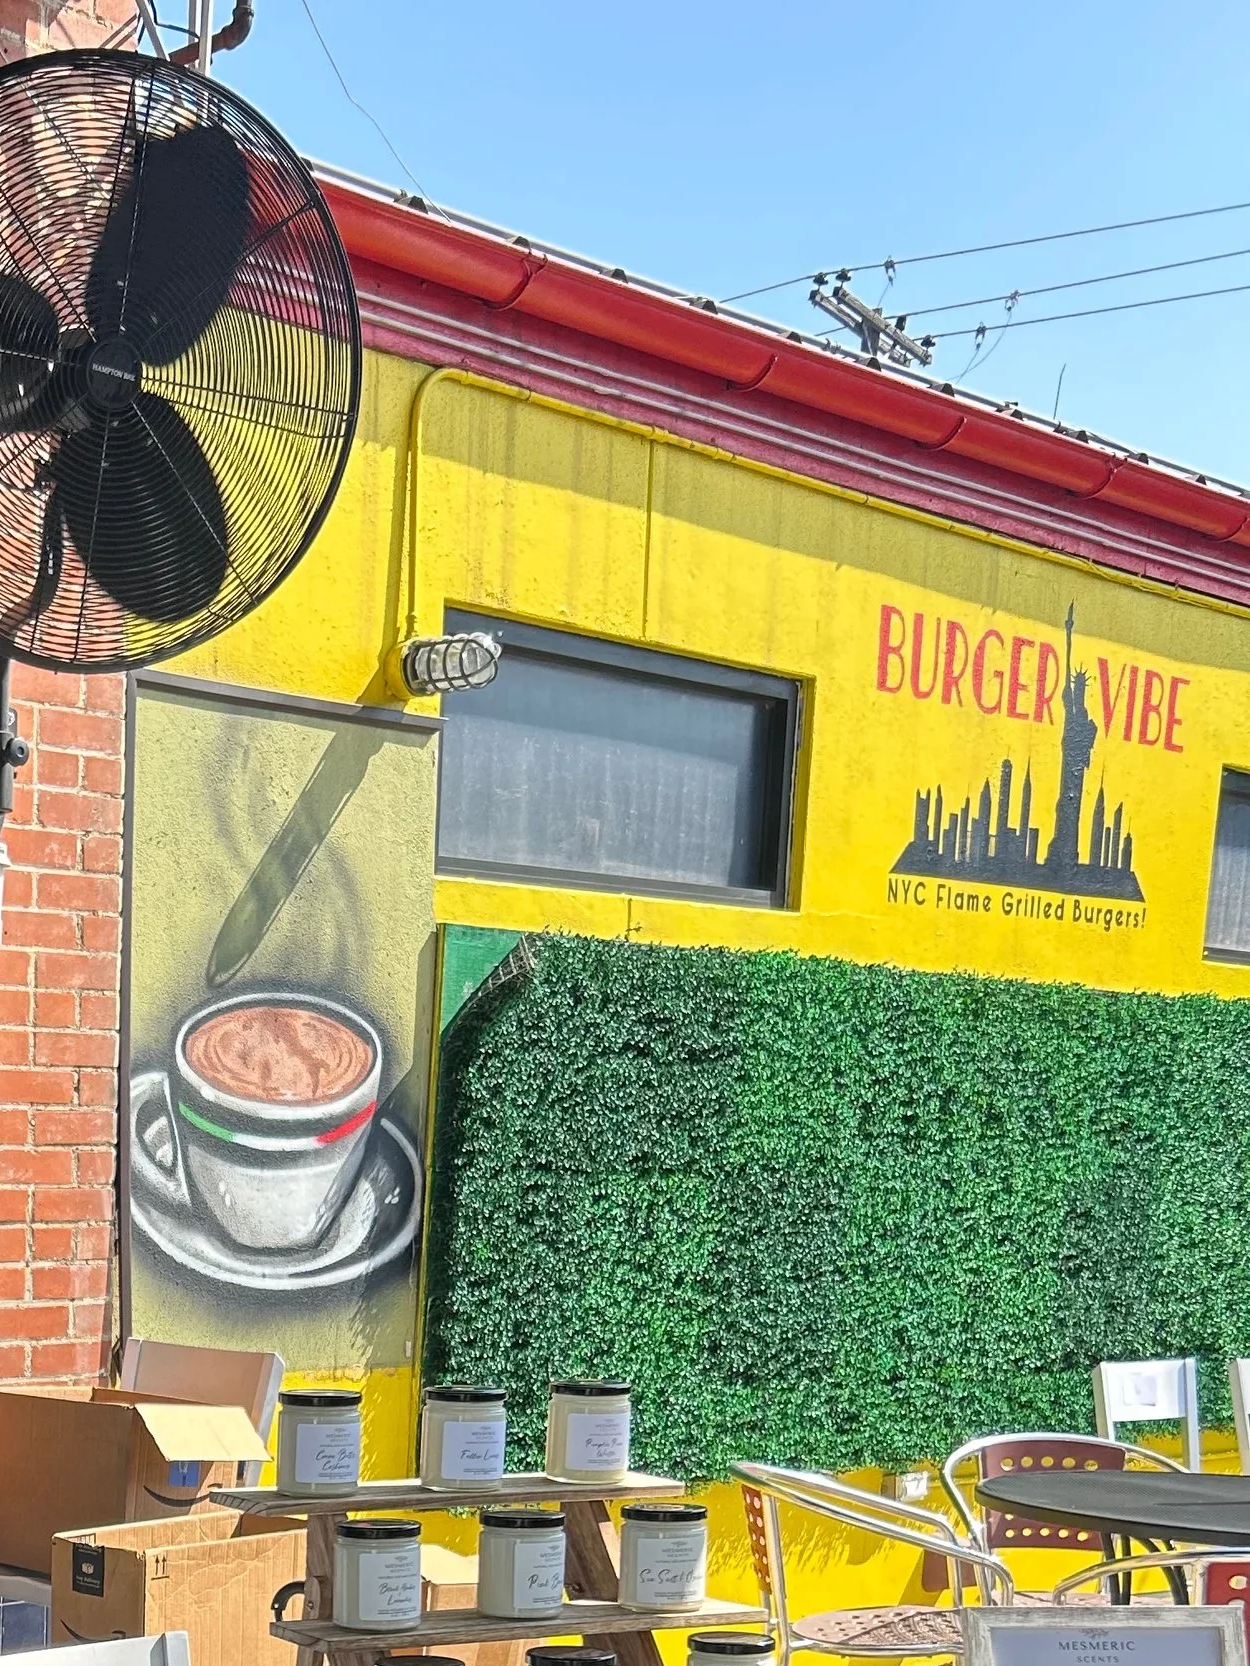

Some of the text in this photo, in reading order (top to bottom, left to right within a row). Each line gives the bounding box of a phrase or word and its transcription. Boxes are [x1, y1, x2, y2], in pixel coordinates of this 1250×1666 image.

[877, 605, 1191, 753] BURGER VIBE
[887, 878, 1147, 931] NYC Flame Grilled Burgers!
[1058, 1640, 1135, 1651] MESMERIC
[1077, 1655, 1119, 1664] SCENTS
